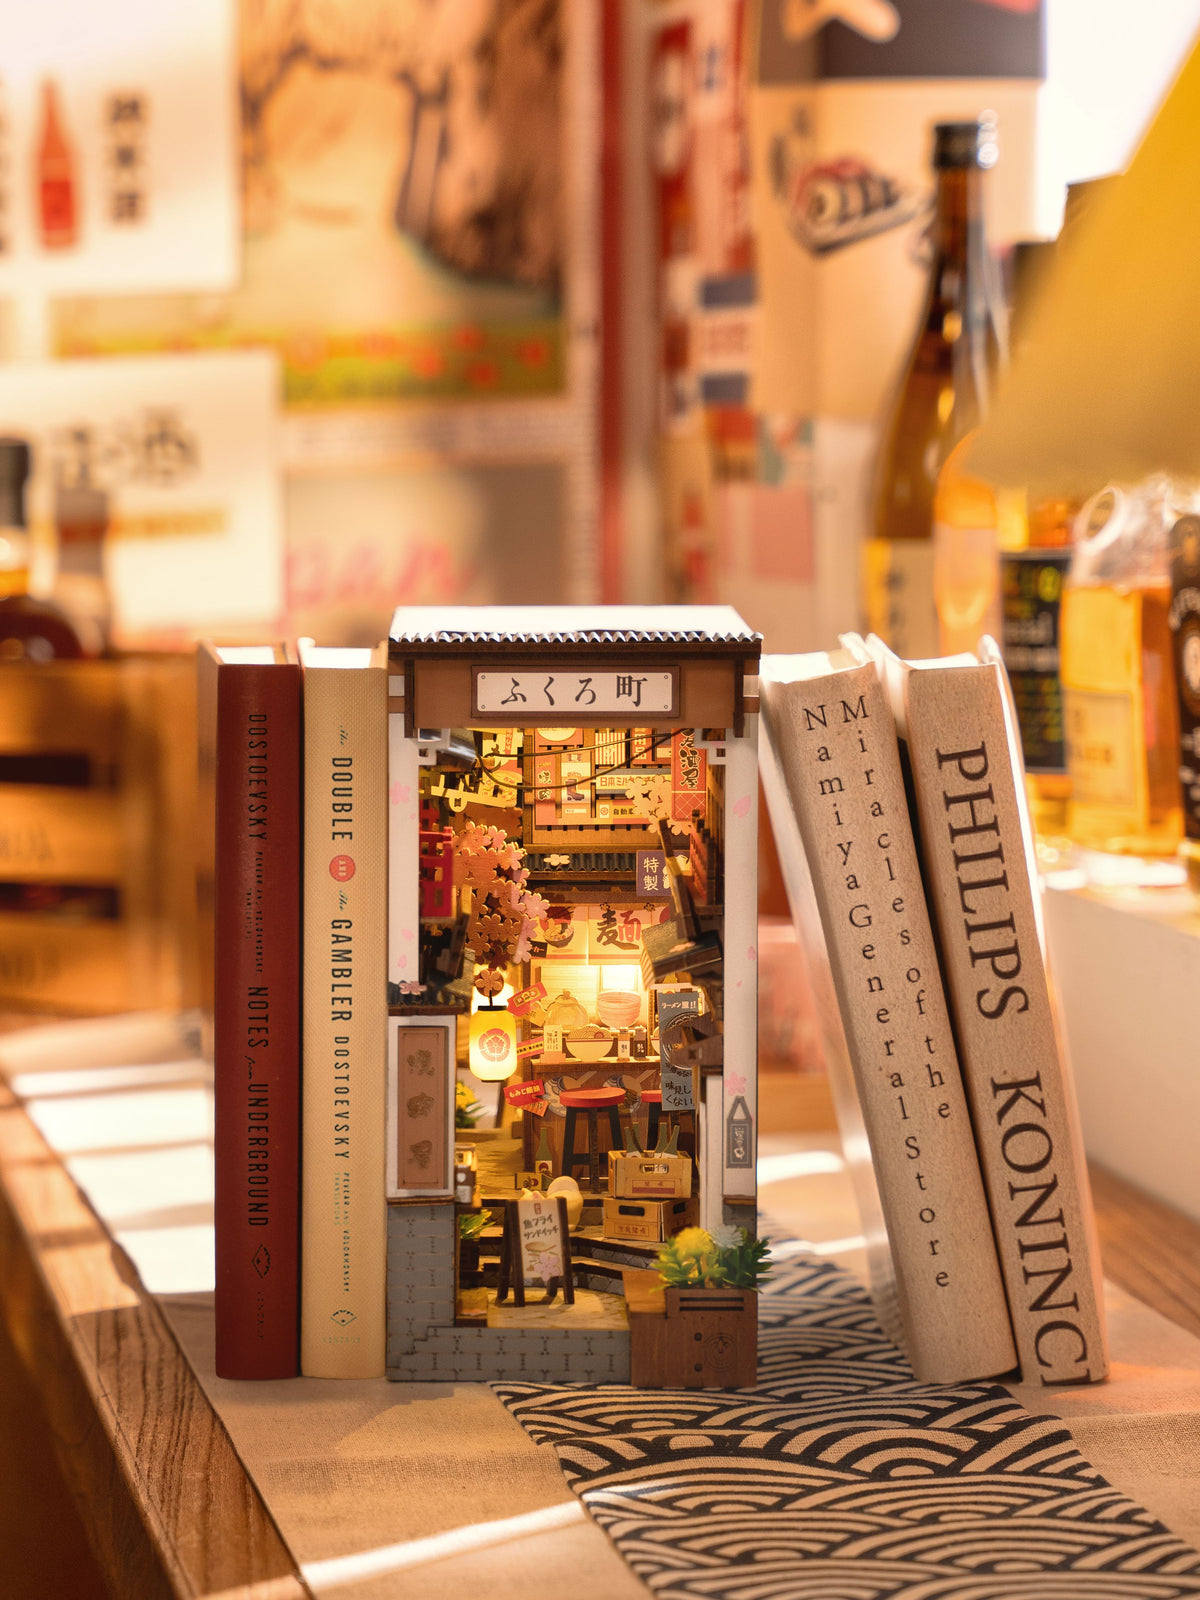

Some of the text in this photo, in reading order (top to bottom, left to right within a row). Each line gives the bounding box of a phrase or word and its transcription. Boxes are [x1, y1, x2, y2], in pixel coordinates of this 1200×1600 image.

[500, 674, 649, 708] ふくろ町
[248, 713, 268, 840] DOSTOEVSKY
[331, 757, 353, 841] DOUBLE
[643, 857, 660, 891] 特製
[840, 695, 952, 1120] Miracles of the
[936, 741, 1030, 1020] PHILIPS
[331, 919, 353, 1023] GAMBLER
[803, 704, 951, 1288] Namiya General Store
[244, 986, 269, 1227] NOTES from UNDERGROUND
[334, 1036, 350, 1160] DOSTOEVSKY
